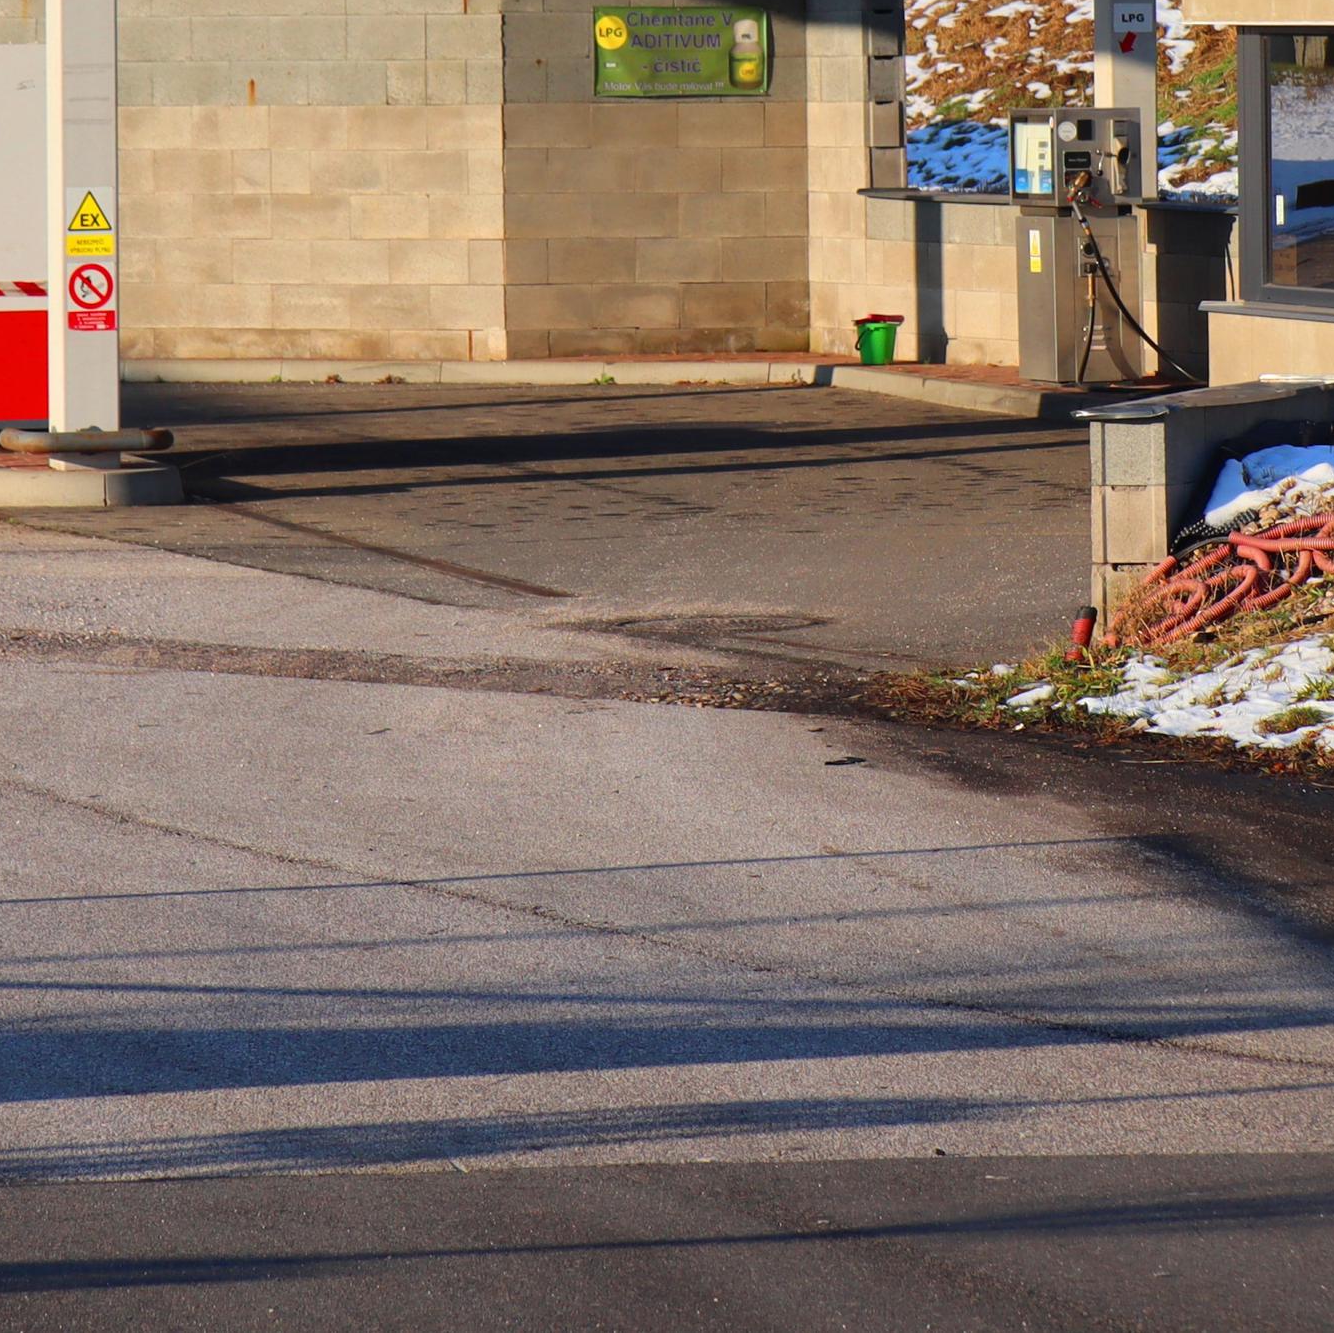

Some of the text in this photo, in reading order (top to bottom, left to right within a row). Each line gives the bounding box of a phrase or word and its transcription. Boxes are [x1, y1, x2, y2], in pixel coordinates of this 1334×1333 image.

[626, 11, 715, 27] Chemtane
[1120, 12, 1145, 24] LPG
[598, 27, 623, 38] LPG
[630, 33, 721, 49] ADITIVUM
[80, 214, 100, 227] EX
